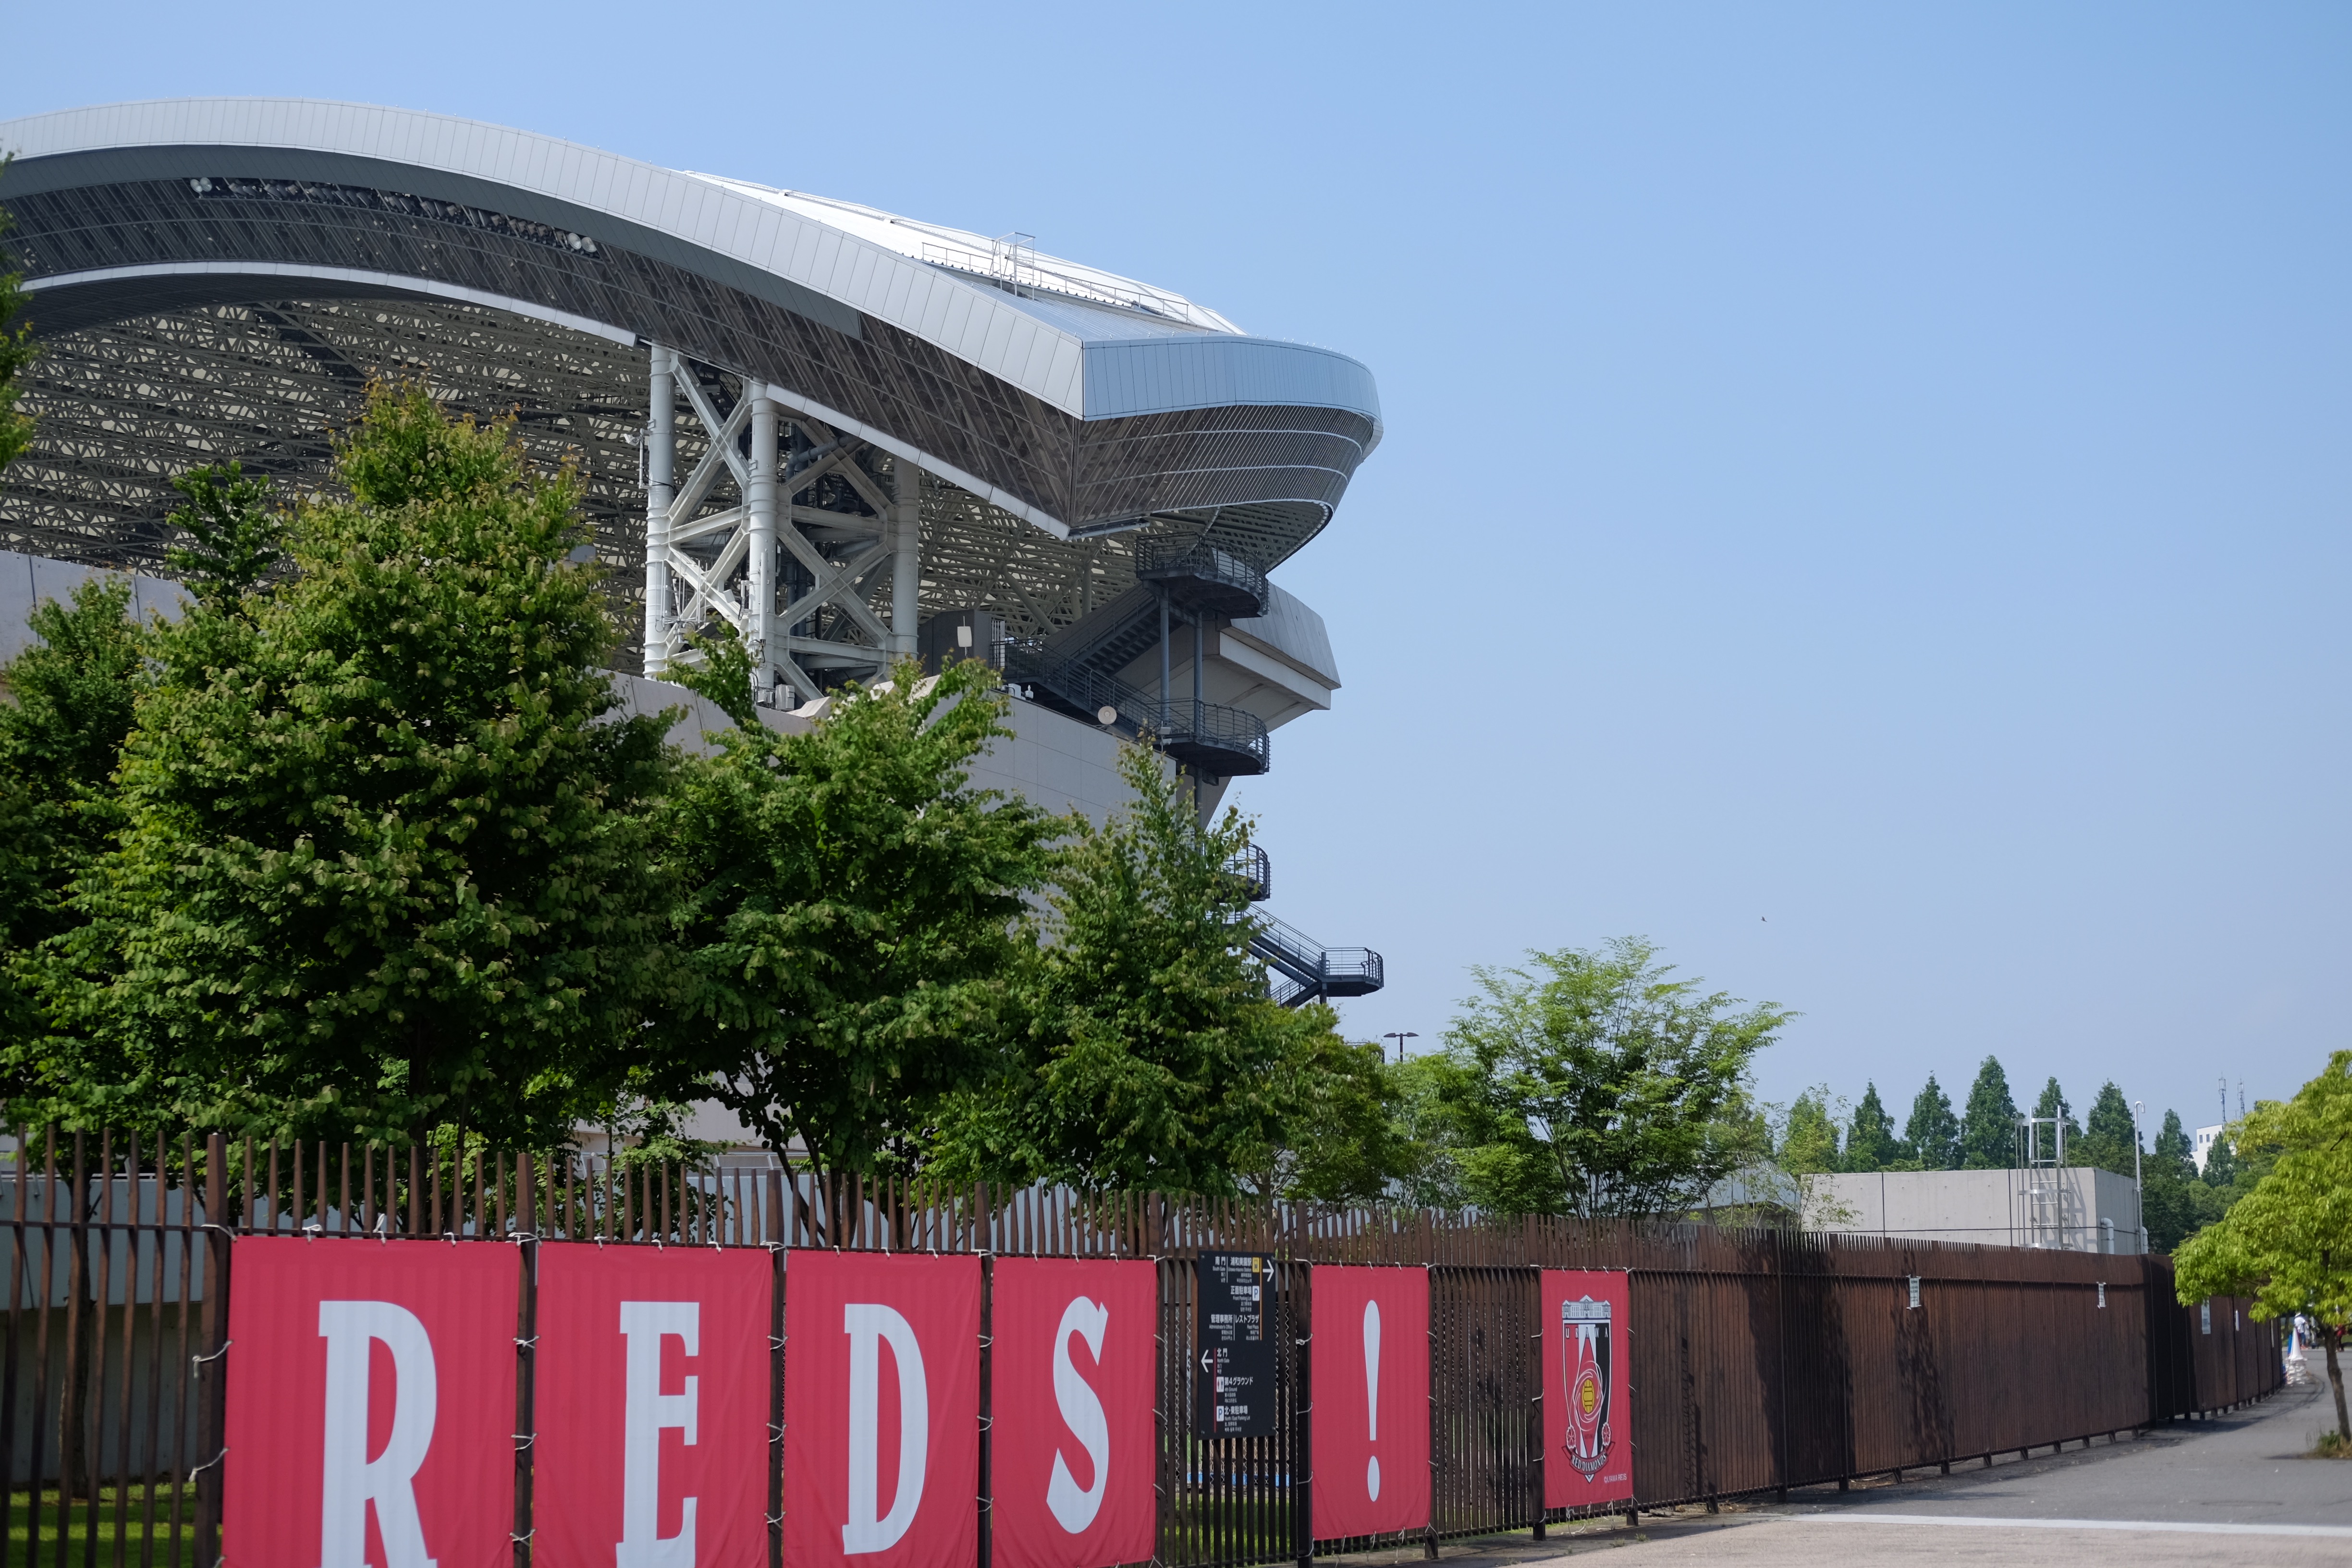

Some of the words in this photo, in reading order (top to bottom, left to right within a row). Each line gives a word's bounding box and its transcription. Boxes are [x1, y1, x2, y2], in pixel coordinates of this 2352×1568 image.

[1230, 1257, 1252, 1266] 浦和美園駅
[1230, 1286, 1252, 1295] 正面駐車場
[1211, 1314, 1233, 1323] 管理事務所
[1235, 1314, 1259, 1323] レストプラザ
[1566, 1327, 1608, 1339] URAWA
[1224, 1376, 1253, 1385] 第4グラウンド
[1572, 1454, 1581, 1469] RED
[1582, 1452, 1606, 1472] DIAMONDS
